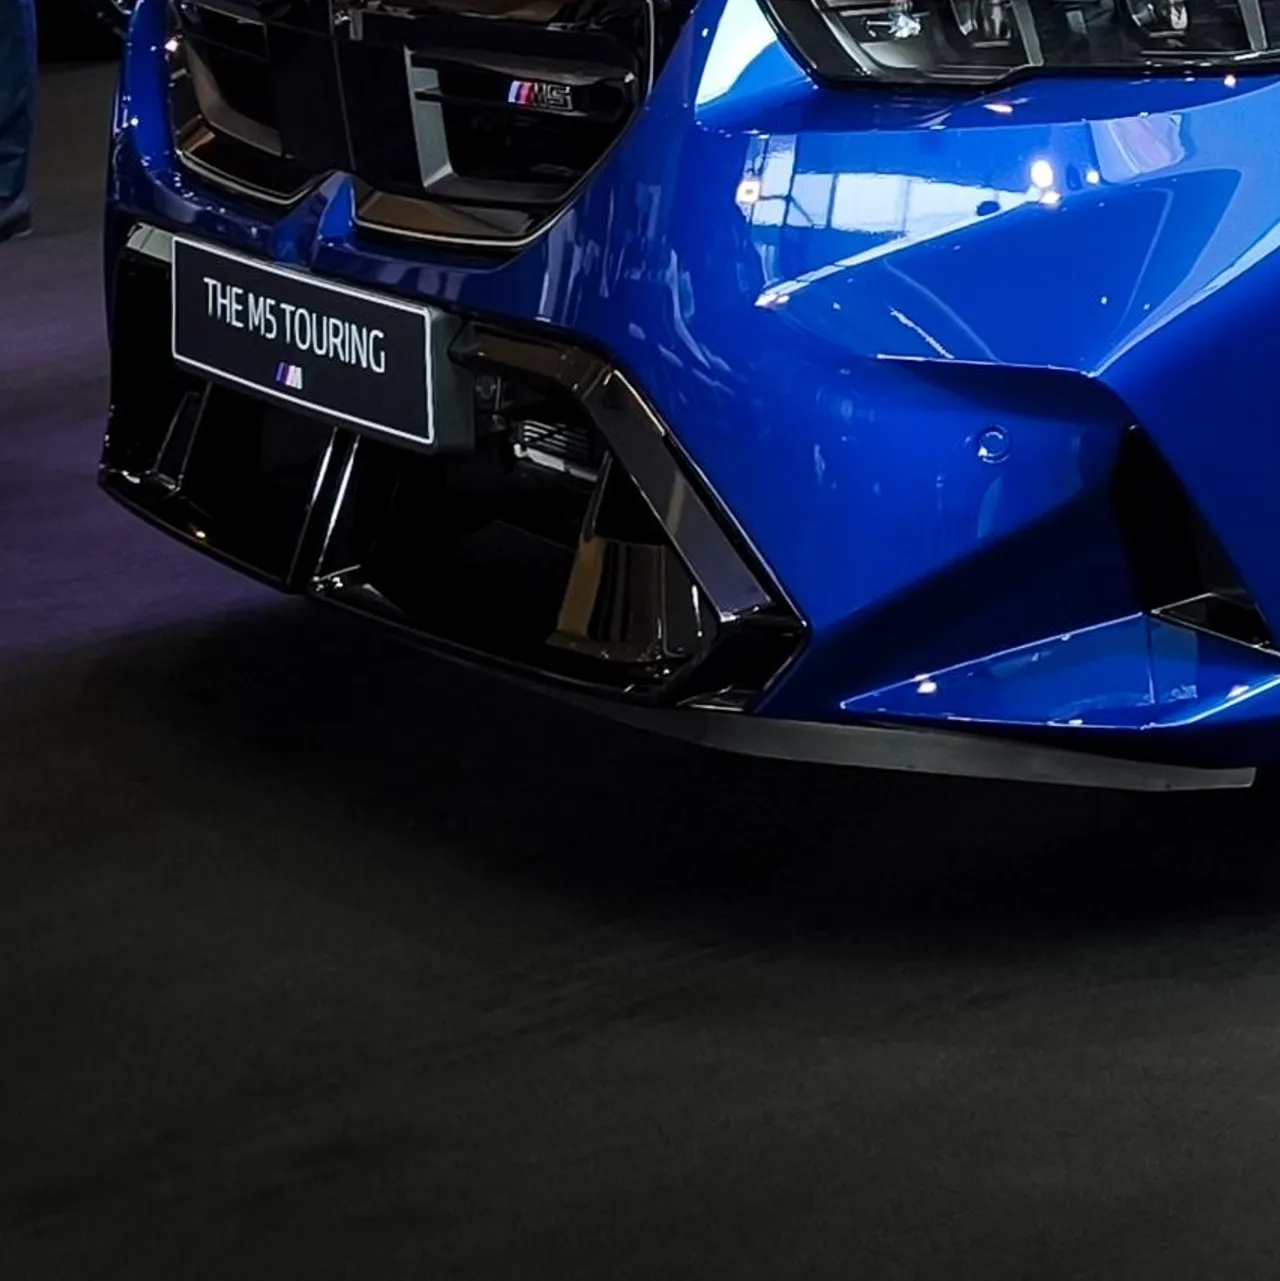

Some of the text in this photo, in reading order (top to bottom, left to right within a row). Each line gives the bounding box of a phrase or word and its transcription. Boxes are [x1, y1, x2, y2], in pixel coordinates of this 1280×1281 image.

[203, 277, 386, 373] THE M5 TOURING
